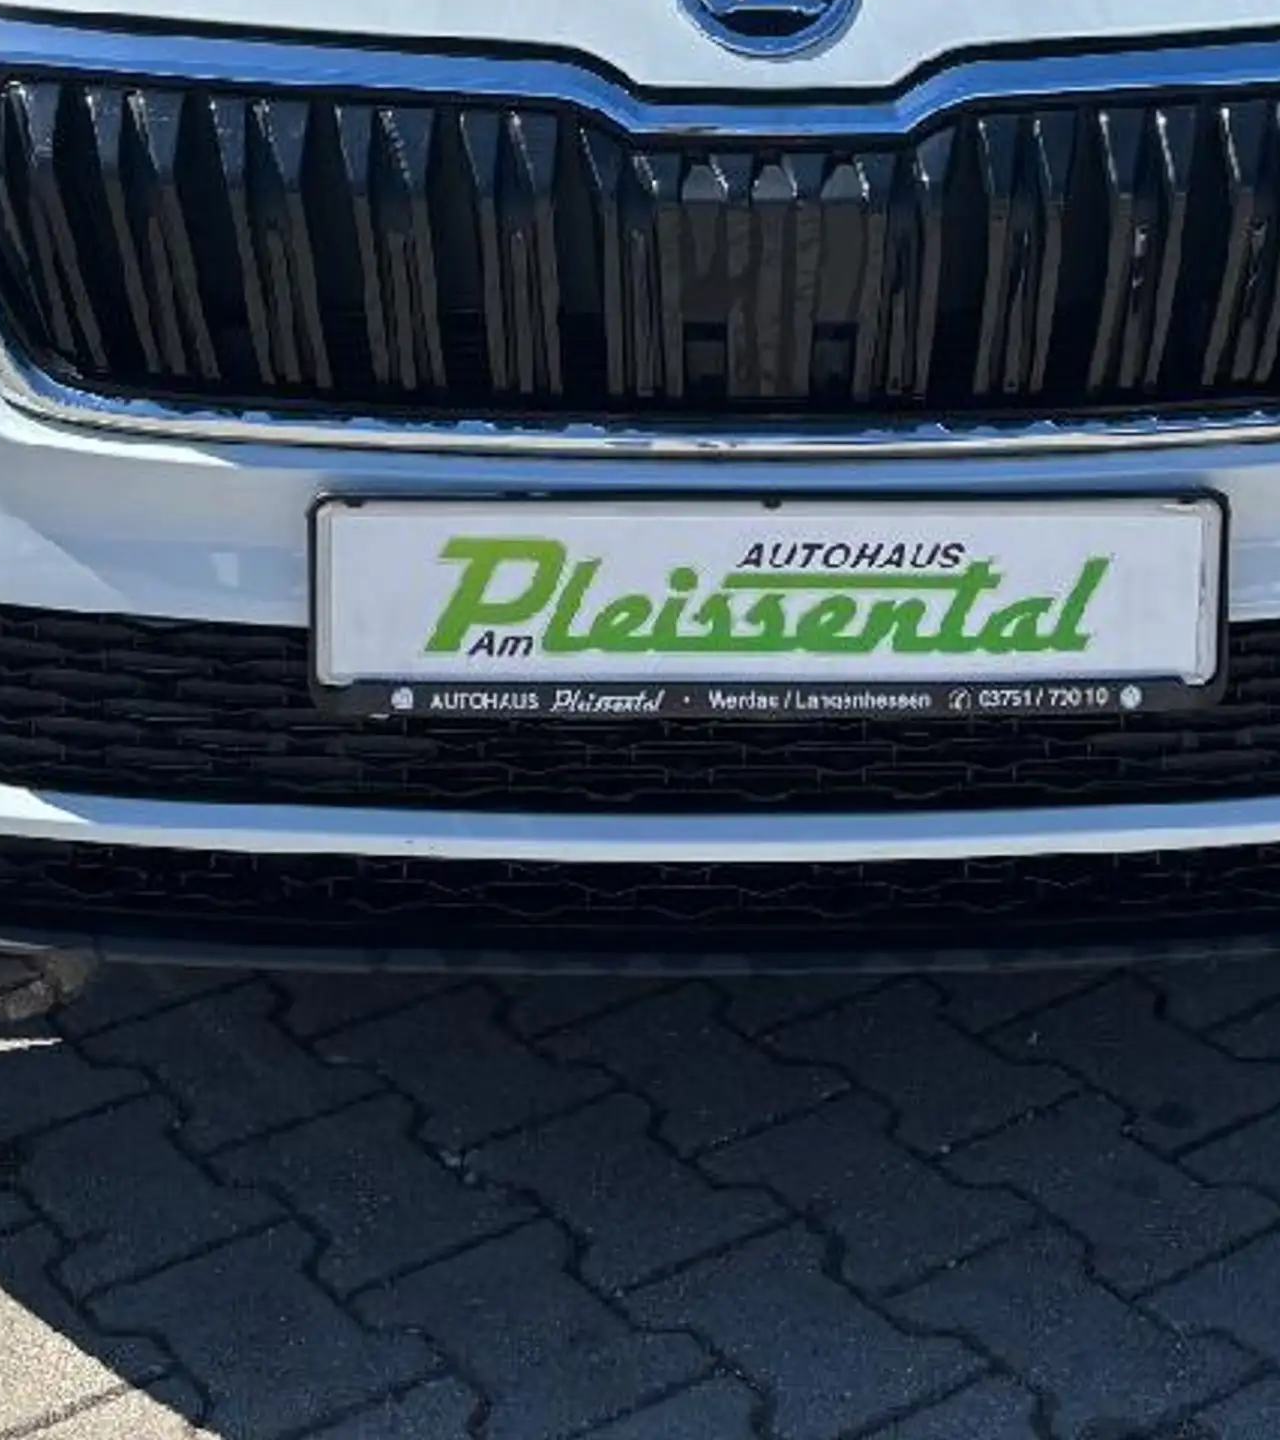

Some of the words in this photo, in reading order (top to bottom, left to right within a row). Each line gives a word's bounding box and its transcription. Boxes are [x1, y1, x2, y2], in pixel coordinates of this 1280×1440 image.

[736, 541, 966, 569] AUTOHAUS
[424, 535, 1111, 654] Pleissental
[468, 630, 534, 658] Am
[429, 691, 540, 711] AUTOHAUS
[550, 689, 666, 713] Pleissental
